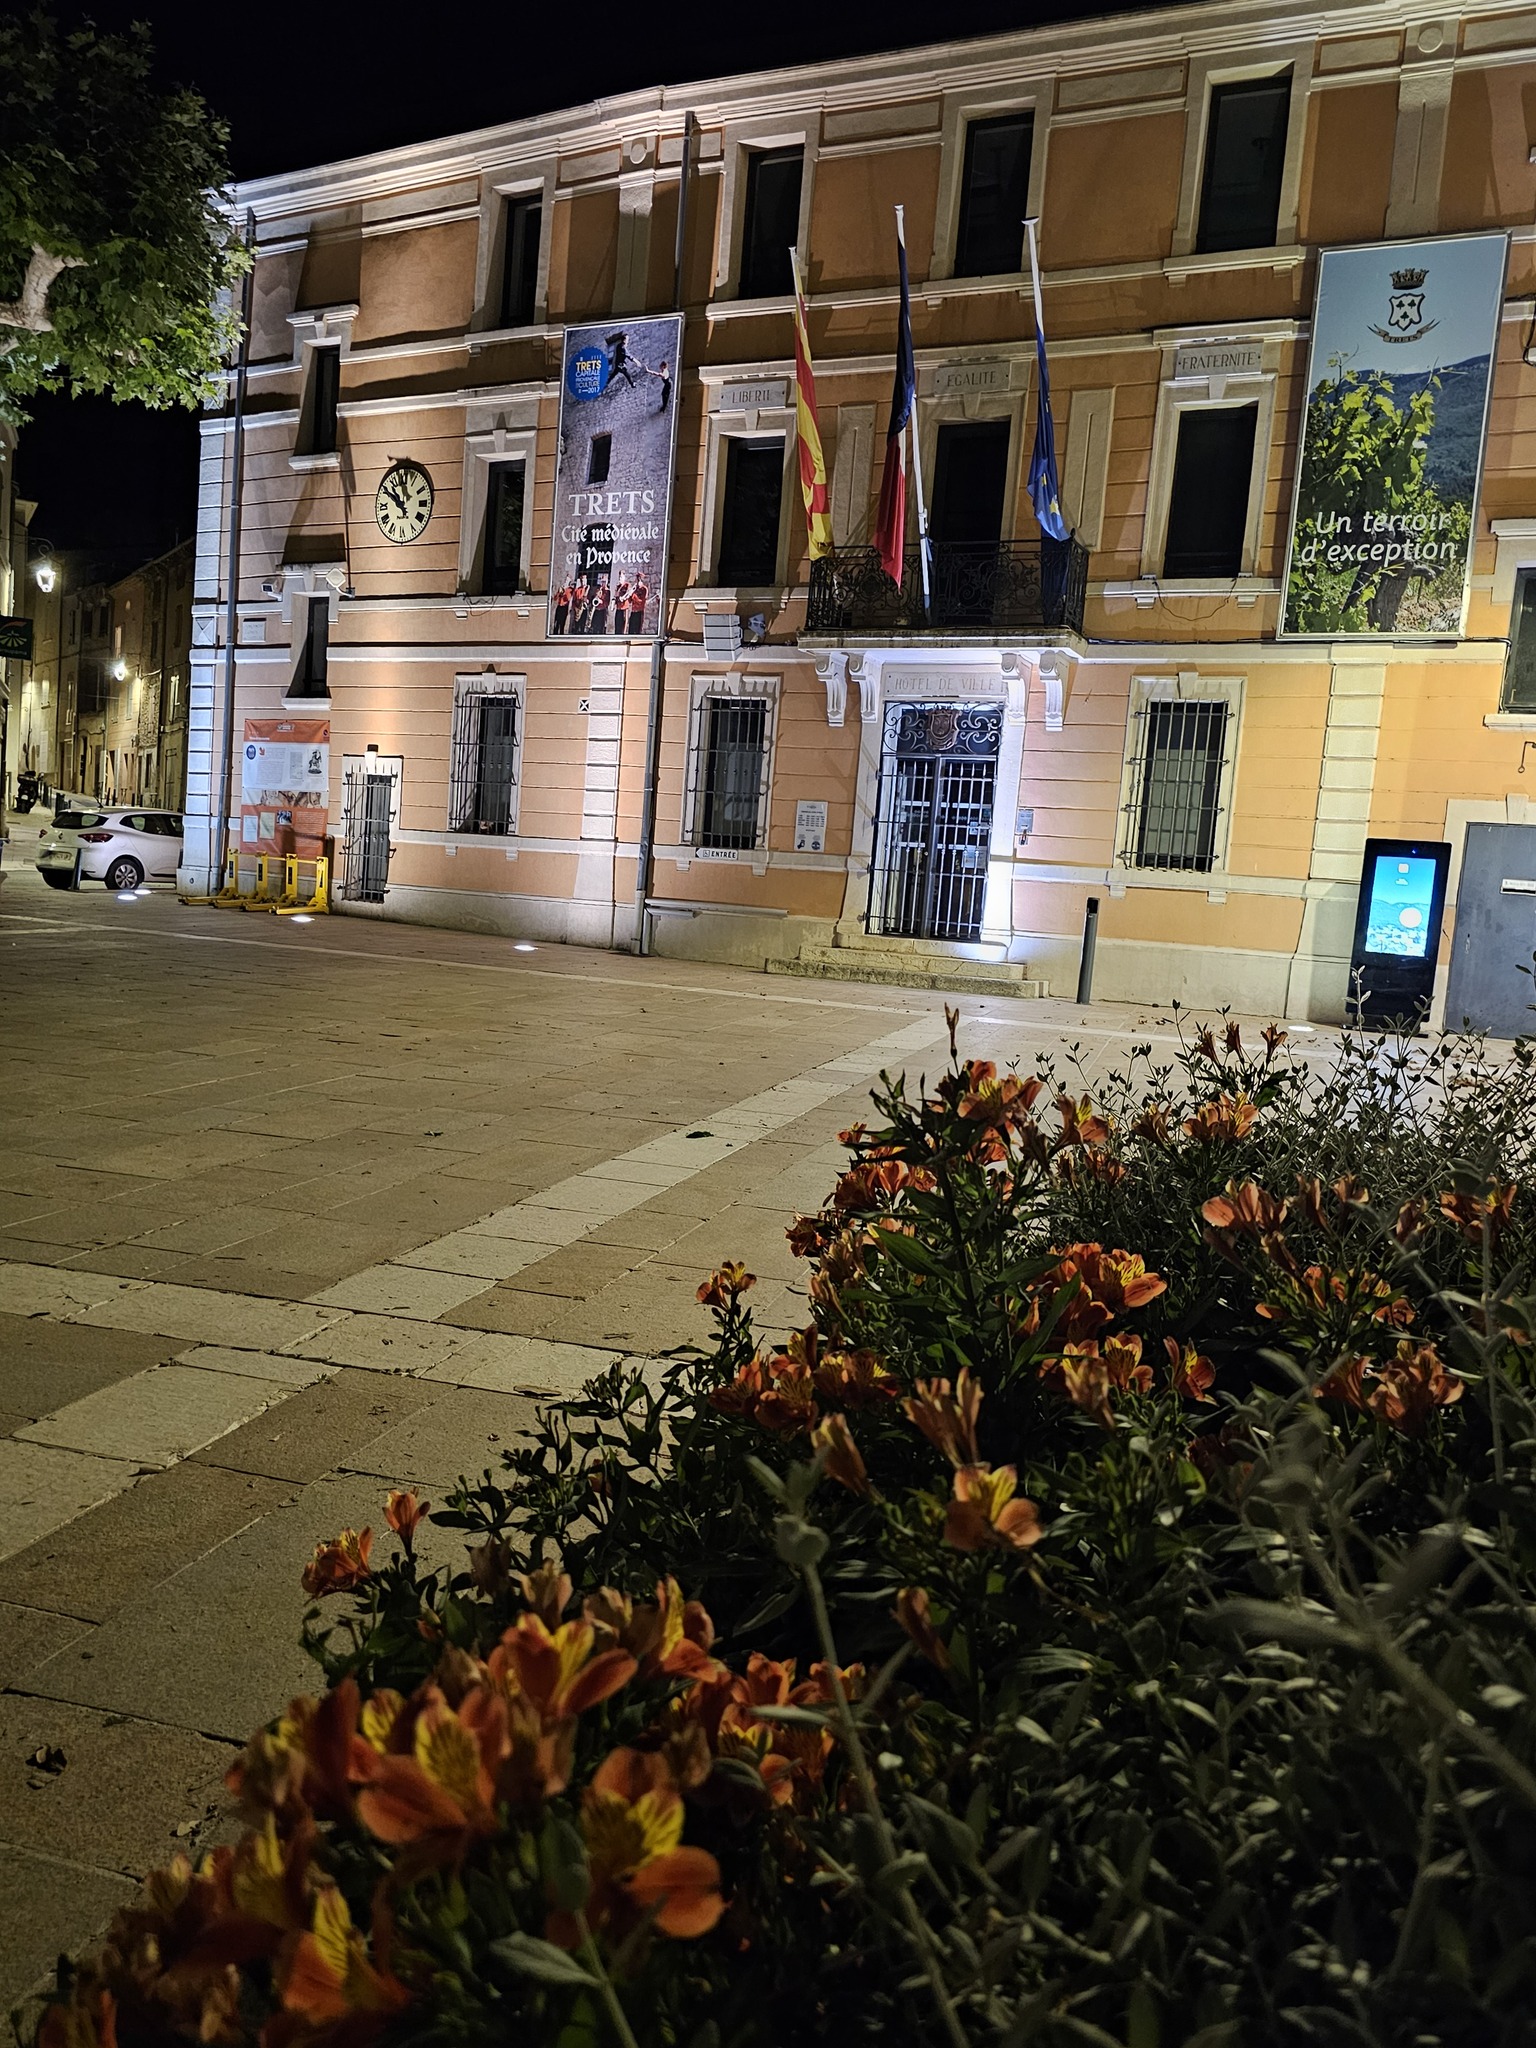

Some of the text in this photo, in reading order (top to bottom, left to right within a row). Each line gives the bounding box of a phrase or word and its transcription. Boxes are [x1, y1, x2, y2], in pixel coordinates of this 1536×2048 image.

[1388, 335, 1418, 343] TRETS
[576, 360, 602, 371] TRETS
[568, 489, 655, 517] TRETS
[1316, 511, 1451, 534] Un terroir
[561, 521, 659, 543] Cité médiévale
[566, 546, 651, 569] en Provence
[939, 678, 953, 691] DE
[961, 678, 995, 691] VILLE
[711, 850, 736, 859] ENTRÉE
